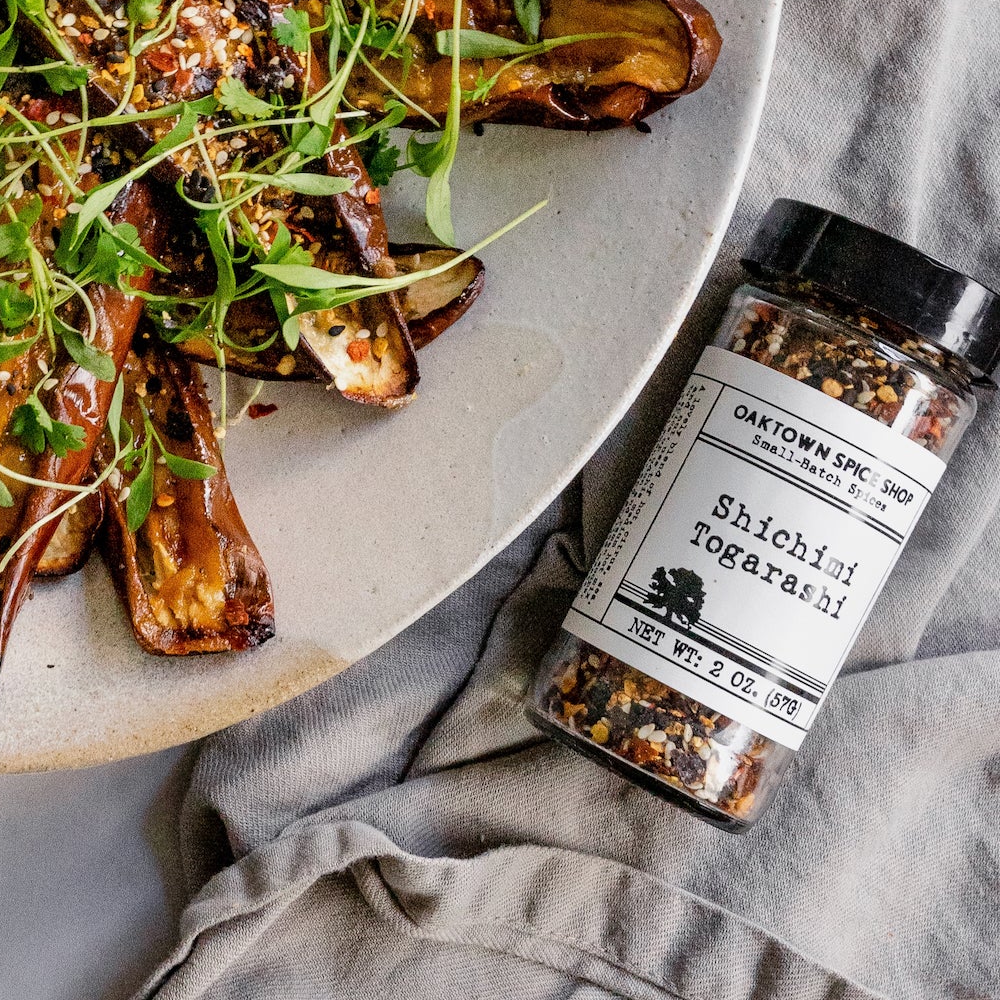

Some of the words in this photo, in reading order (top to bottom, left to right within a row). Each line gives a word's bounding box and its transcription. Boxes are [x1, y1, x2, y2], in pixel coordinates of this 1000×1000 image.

[733, 404, 831, 461] OAKTOWN
[832, 452, 880, 489] SPICE
[880, 478, 915, 506] SHOP
[751, 434, 842, 487] Small-Batch
[849, 483, 888, 512] Spices
[689, 521, 848, 620] Togarashi
[711, 493, 859, 587] Shichimi
[627, 617, 665, 647] NET
[672, 639, 704, 669] WT:
[708, 661, 722, 678] 2
[730, 671, 759, 699] OZ.
[764, 687, 803, 721] (57G)
